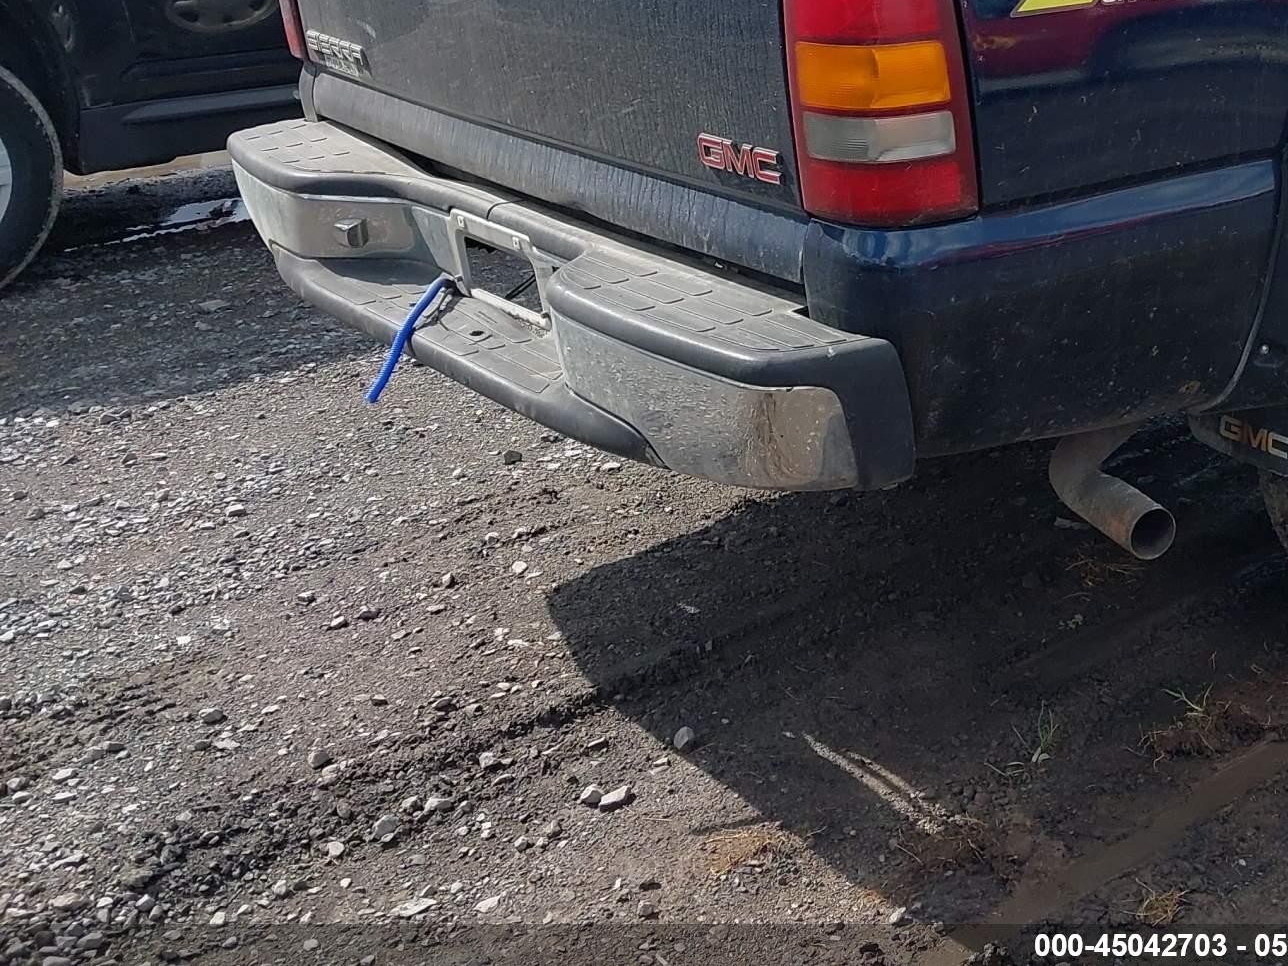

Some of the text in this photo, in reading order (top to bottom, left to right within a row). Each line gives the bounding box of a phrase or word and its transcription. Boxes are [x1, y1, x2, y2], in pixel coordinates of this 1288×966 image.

[306, 29, 364, 66] SIERRA
[697, 132, 782, 185] GMC
[1220, 414, 1288, 459] GMC
